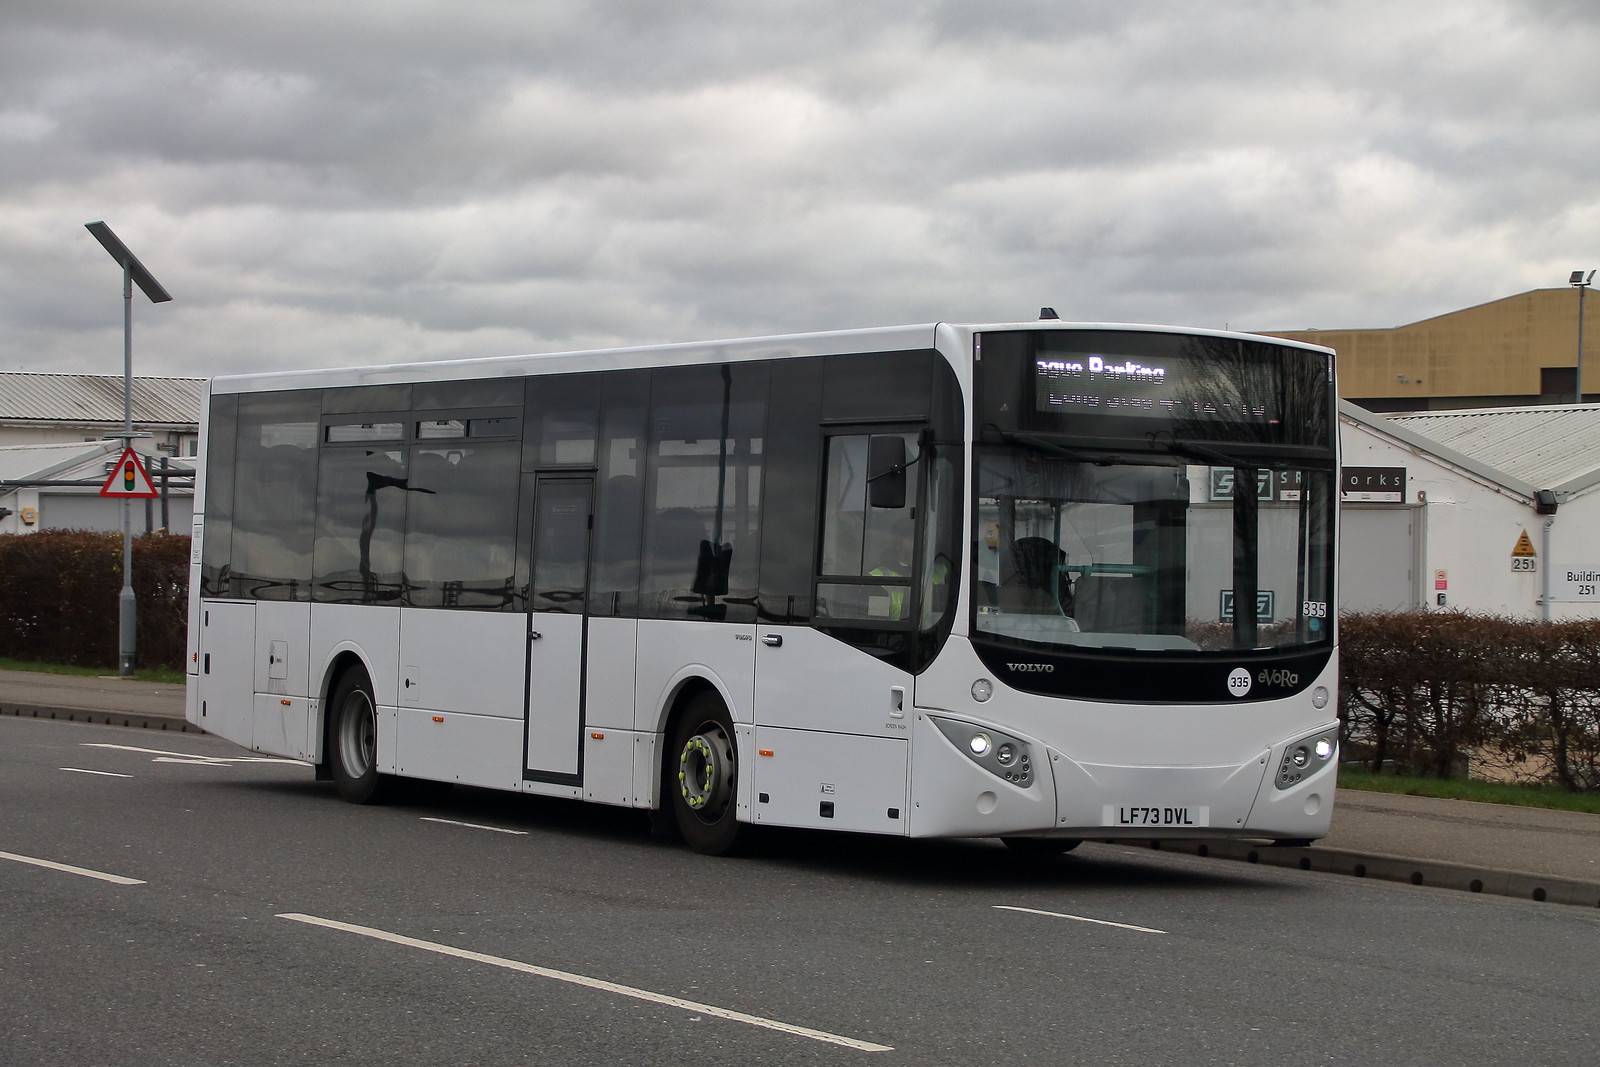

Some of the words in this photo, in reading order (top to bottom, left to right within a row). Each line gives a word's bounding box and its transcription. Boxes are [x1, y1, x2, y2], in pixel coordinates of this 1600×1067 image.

[1088, 355, 1165, 385] Parking
[1513, 559, 1535, 570] 251
[1578, 584, 1595, 595] 251
[1303, 602, 1326, 617] 335
[1006, 663, 1055, 673] VOLVO
[1230, 676, 1249, 688] 335
[1121, 807, 1160, 825] LF73
[1164, 808, 1192, 825] DVL
